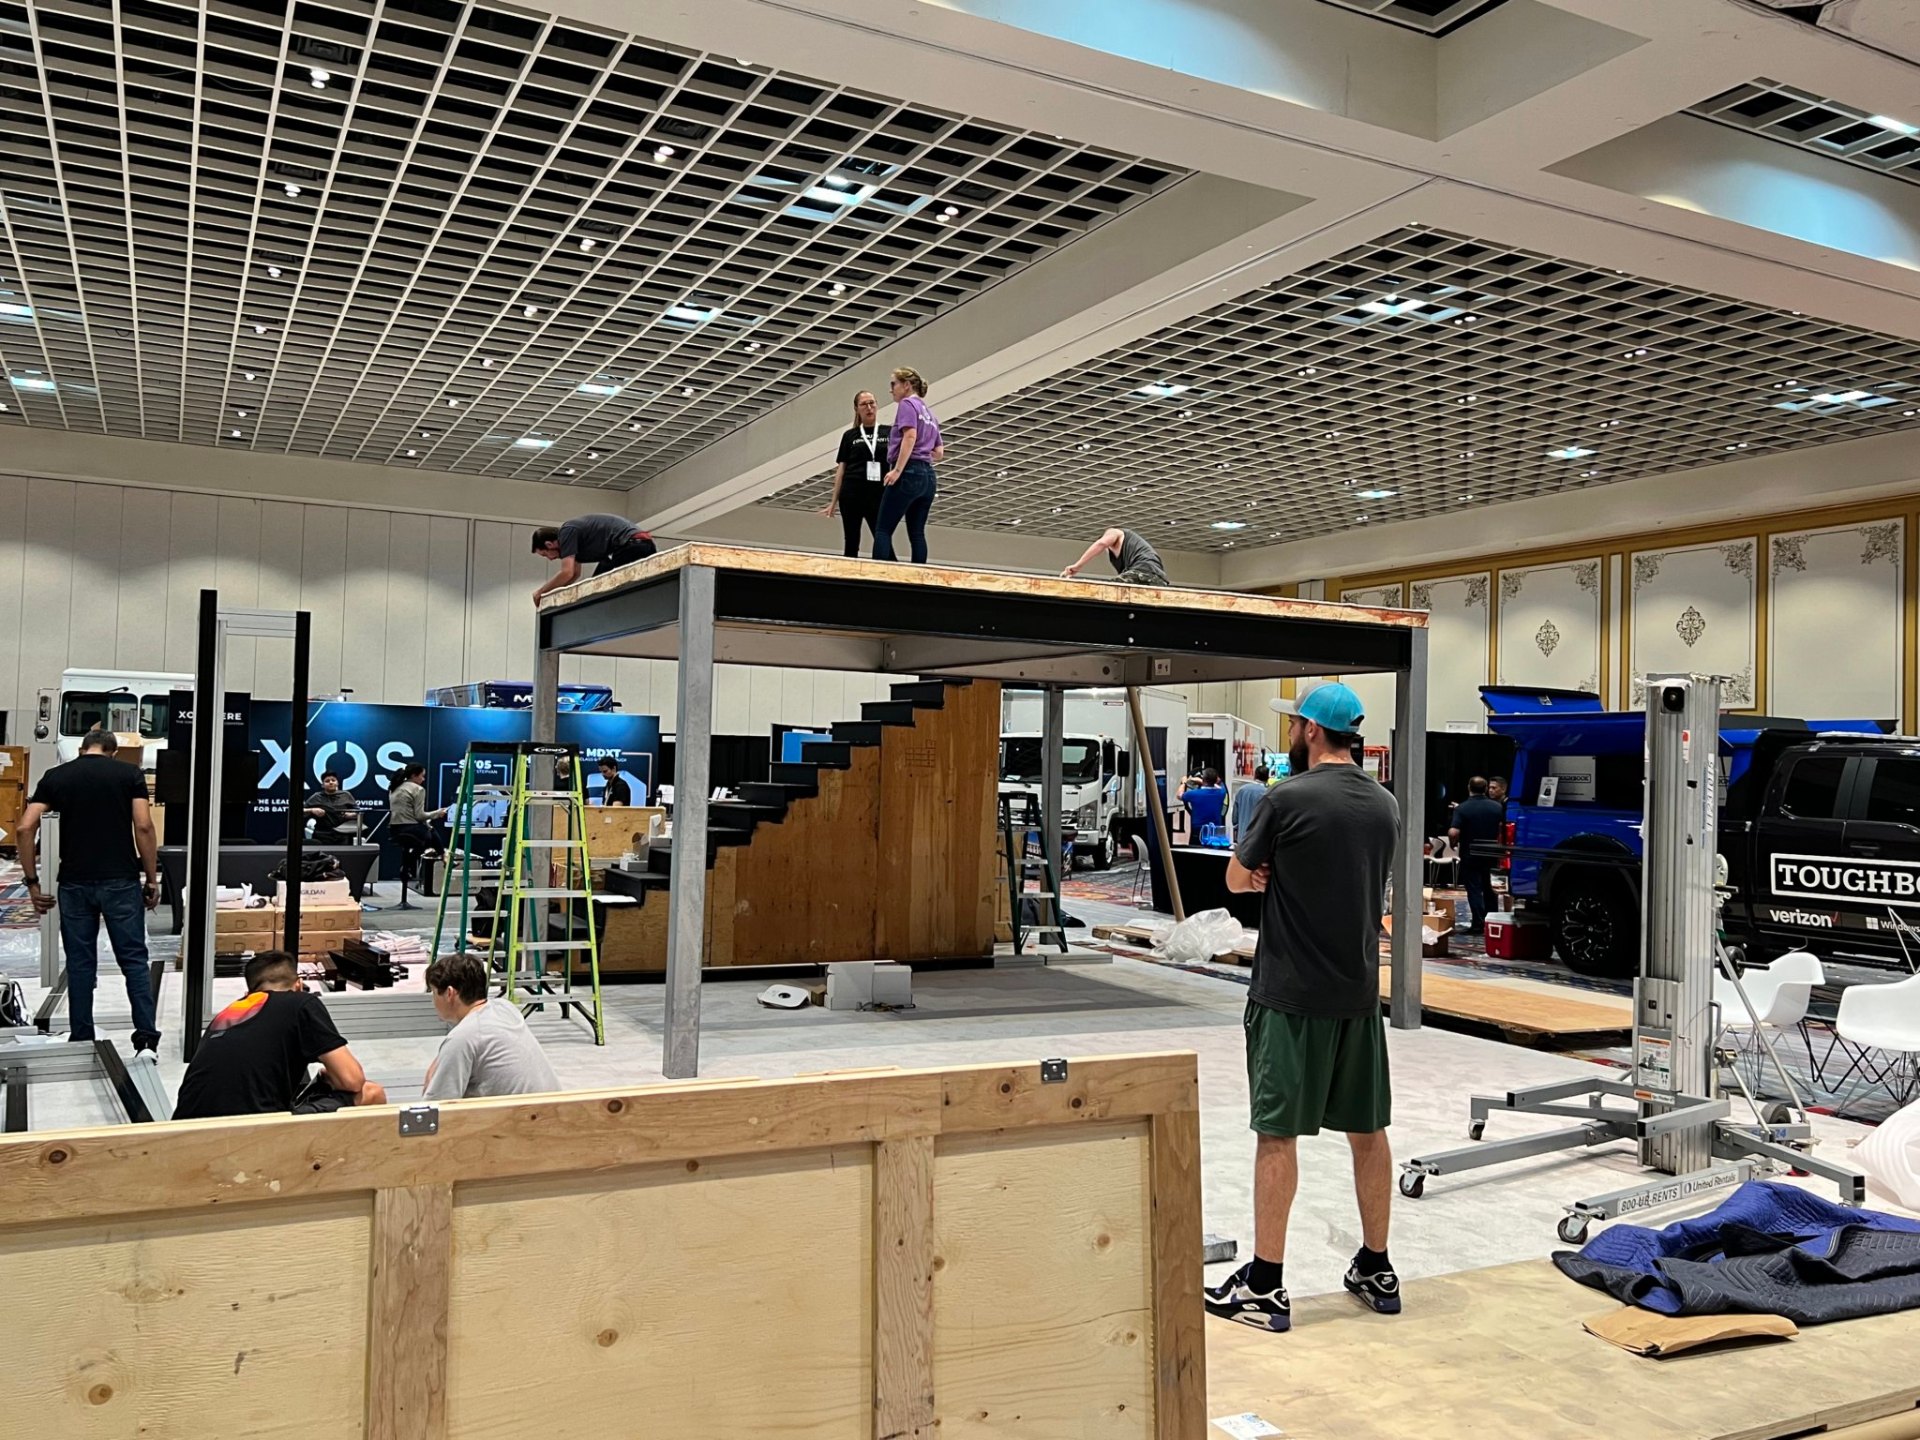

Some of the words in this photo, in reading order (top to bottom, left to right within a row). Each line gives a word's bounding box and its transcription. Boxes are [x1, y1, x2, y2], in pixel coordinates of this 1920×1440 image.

[586, 747, 622, 758] MDXT
[257, 739, 414, 791] XOS
[458, 759, 492, 770] S05
[1777, 863, 1920, 896] TOUGHB
[1769, 908, 1833, 928] verizon
[1692, 1177, 1714, 1193] United
[1714, 1173, 1737, 1188] Rentals
[1620, 1187, 1678, 1212] 800-UR-RENTS
